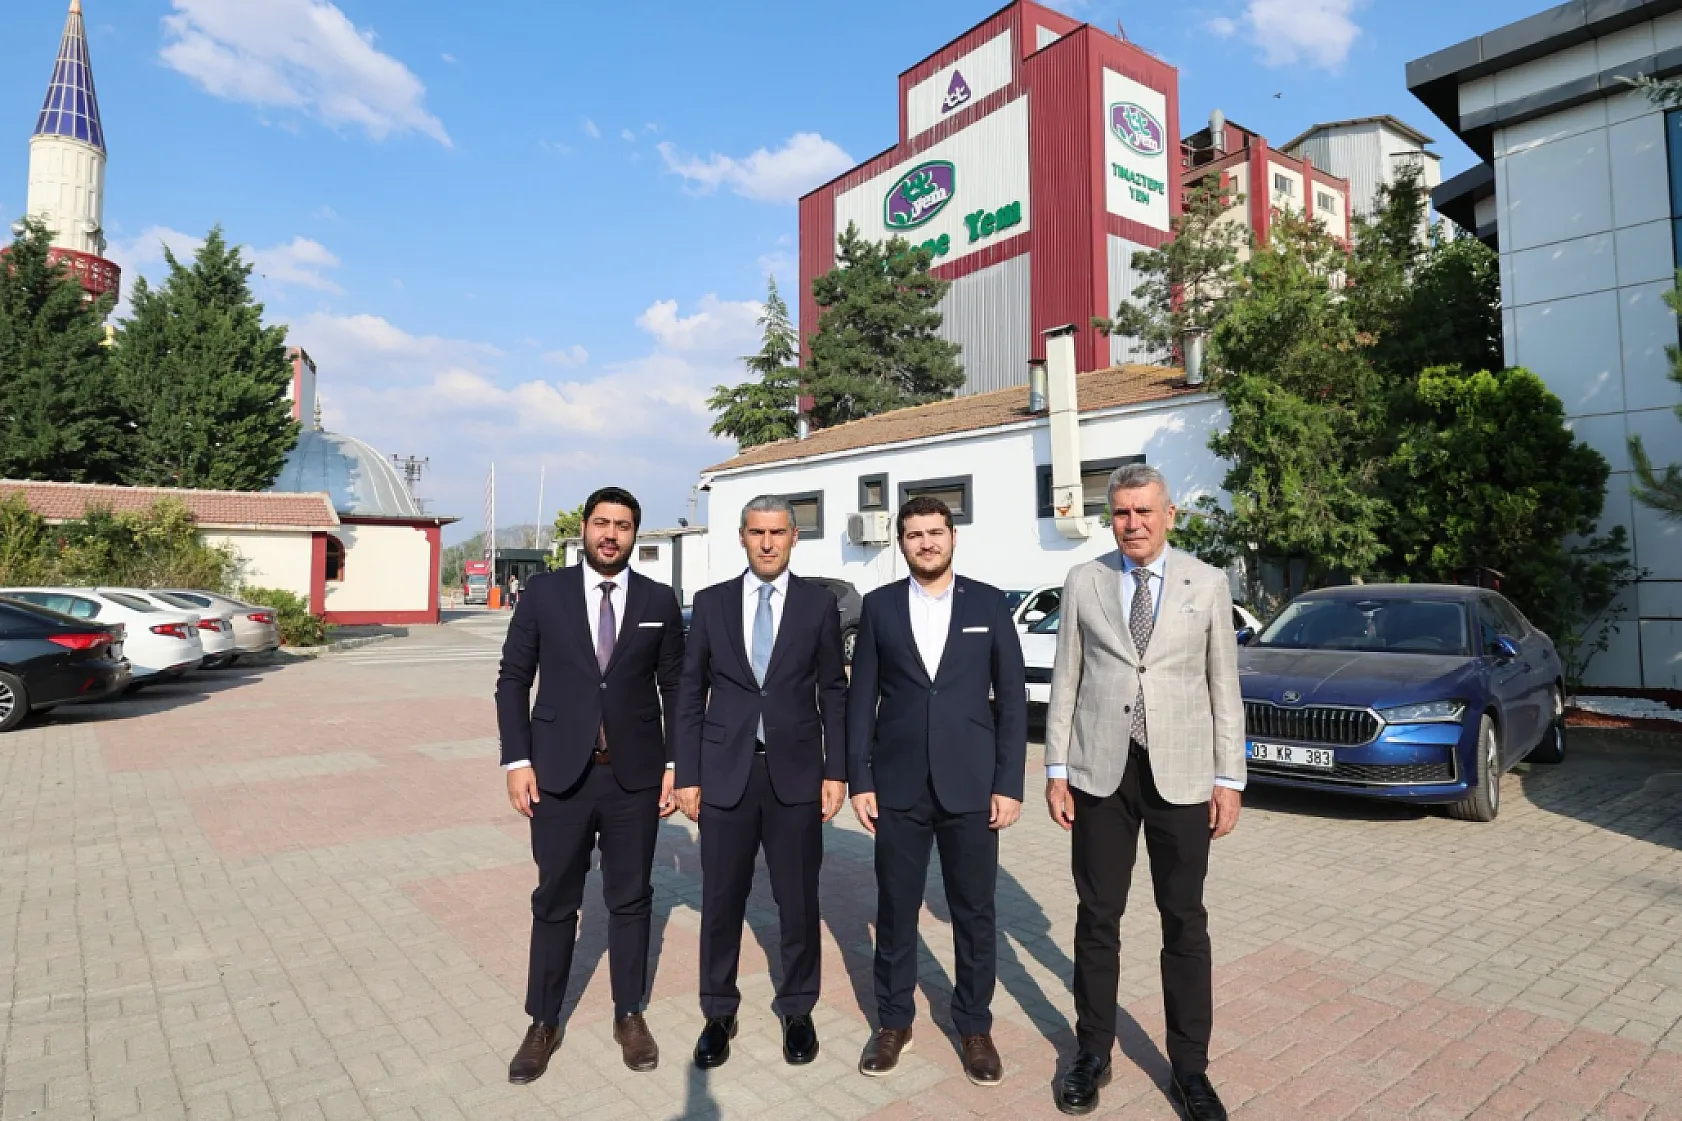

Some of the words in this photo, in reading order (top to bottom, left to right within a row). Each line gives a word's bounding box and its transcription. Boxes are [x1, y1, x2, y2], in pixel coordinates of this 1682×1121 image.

[912, 187, 947, 219] yem
[965, 200, 1022, 244] Yem
[1253, 744, 1268, 759] 03
[1276, 746, 1292, 761] KR
[1305, 749, 1331, 766] 383
